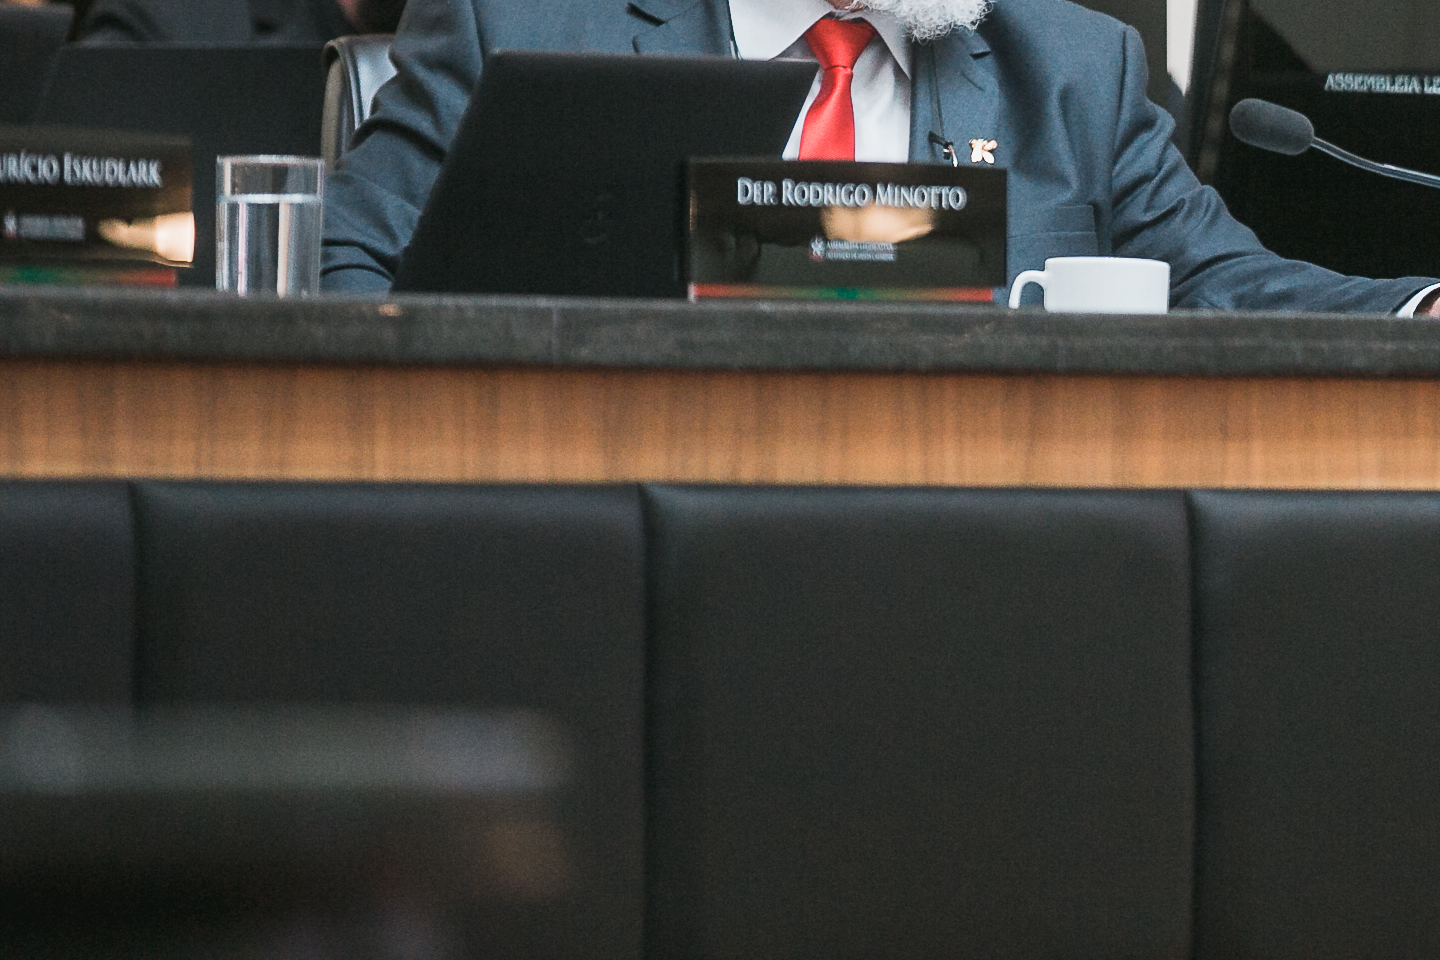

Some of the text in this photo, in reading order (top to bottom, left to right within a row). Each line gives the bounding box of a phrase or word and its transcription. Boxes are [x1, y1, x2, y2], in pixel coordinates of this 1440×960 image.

[1324, 72, 1421, 93] ASSEMBLEIA
[737, 176, 968, 210] DEP. RODRIGO MINOTTO
